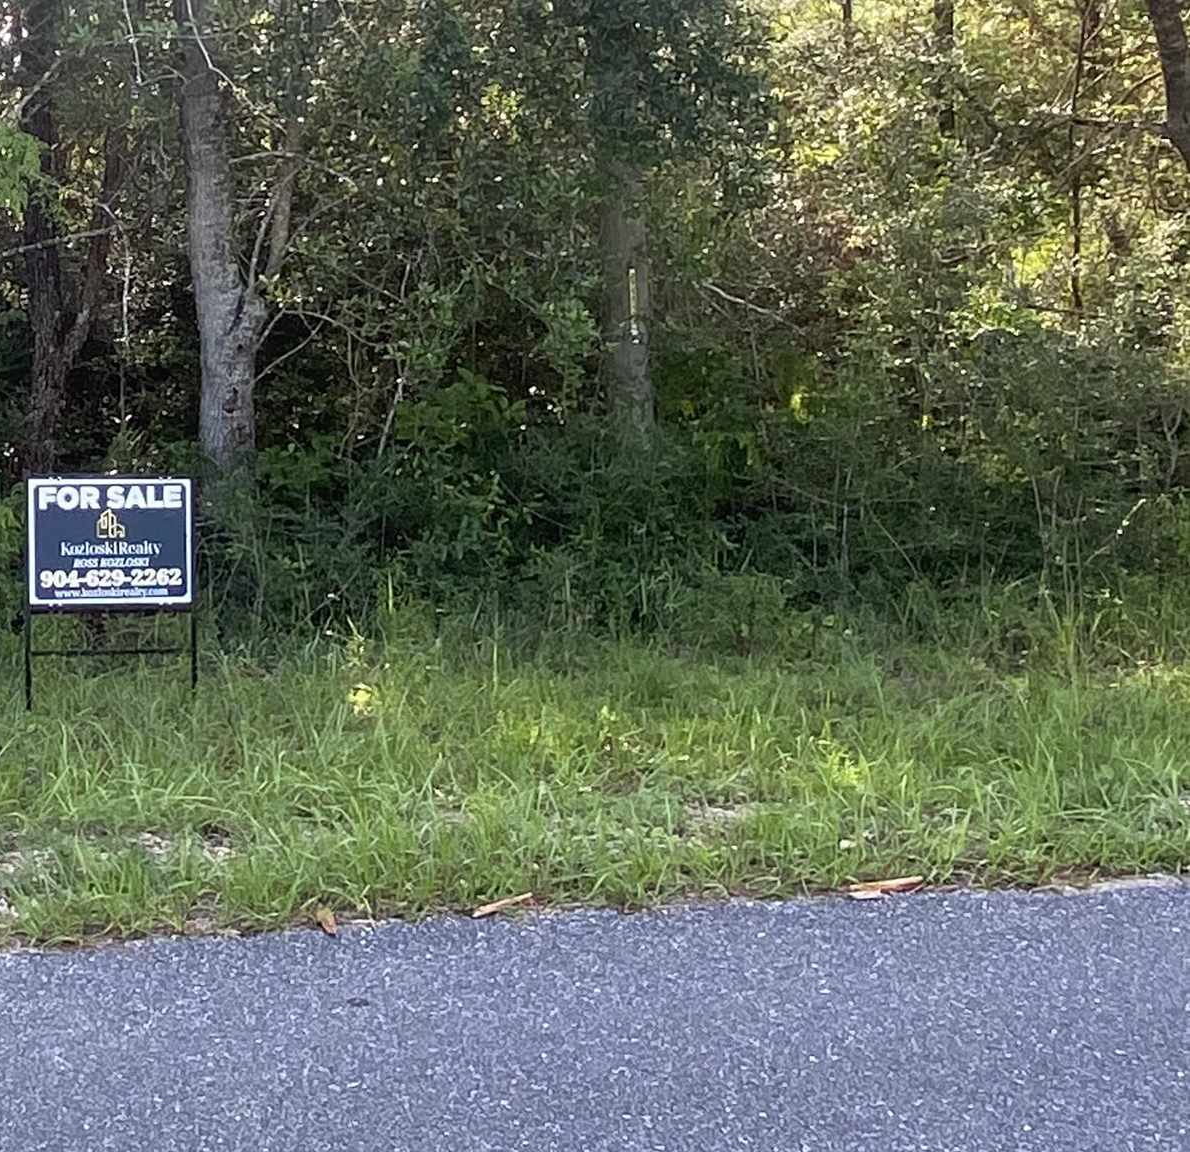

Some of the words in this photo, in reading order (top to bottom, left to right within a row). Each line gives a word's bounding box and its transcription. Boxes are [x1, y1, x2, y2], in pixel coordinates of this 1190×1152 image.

[39, 486, 101, 510] FOR
[107, 485, 183, 509] SALE
[73, 558, 98, 568] ROSS
[40, 568, 183, 588] 904-629-2262
